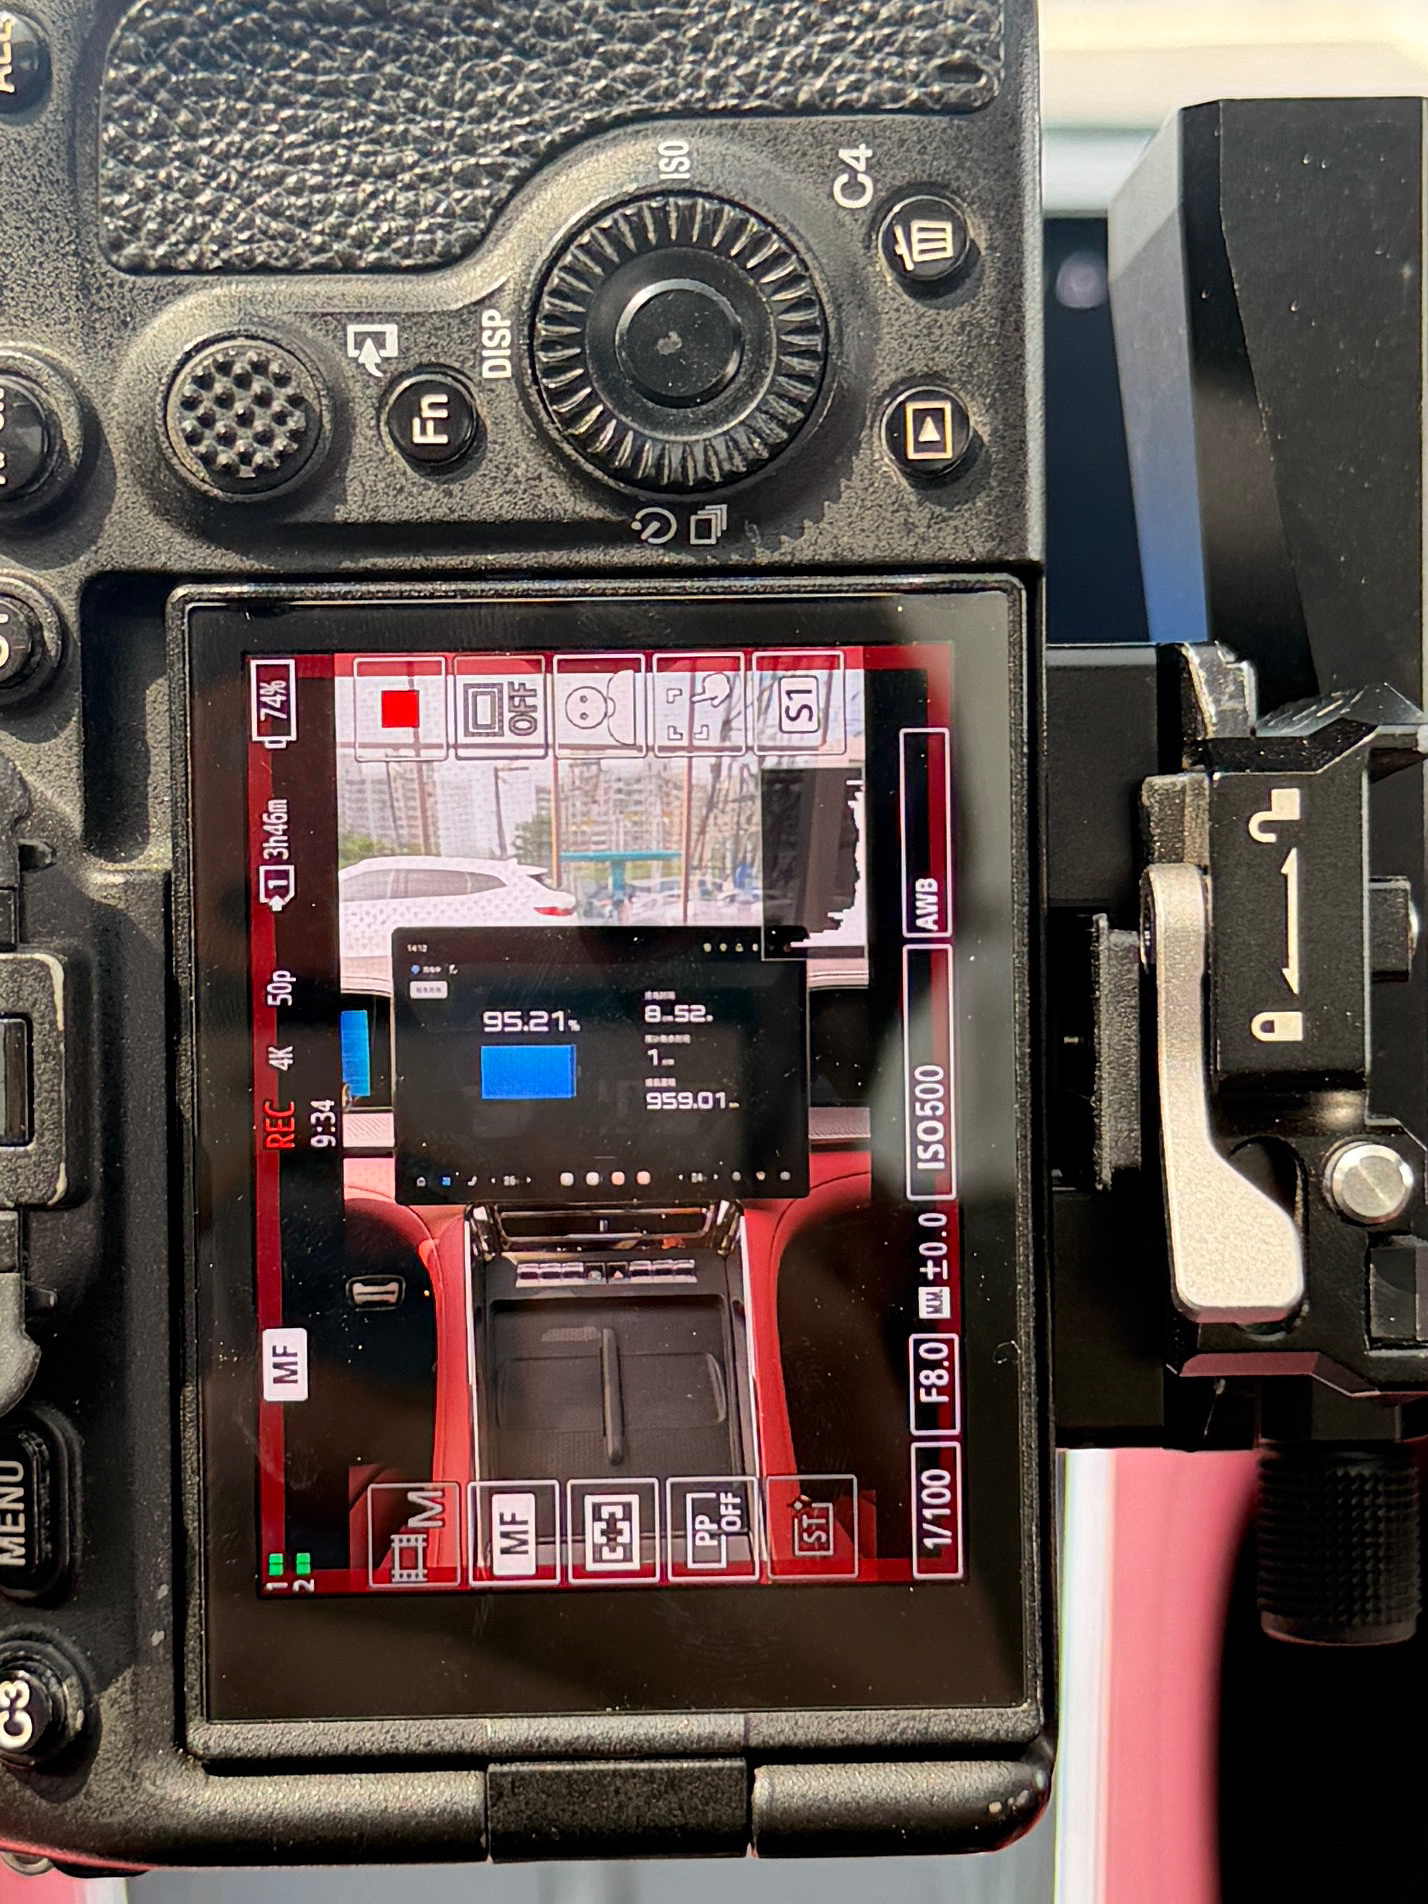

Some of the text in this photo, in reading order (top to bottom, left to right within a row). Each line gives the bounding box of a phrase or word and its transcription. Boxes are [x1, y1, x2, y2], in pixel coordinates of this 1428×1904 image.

[659, 140, 690, 180] ISO
[834, 144, 873, 209] C4
[482, 308, 512, 379] DISP
[411, 393, 449, 445] Fn
[260, 679, 287, 722] 74%
[507, 680, 538, 736] OFF
[262, 798, 289, 860] 3h46m
[915, 878, 939, 931] AWB
[267, 970, 297, 1006] 50p
[268, 1045, 294, 1072] 4K
[264, 1100, 295, 1151] REC
[310, 1099, 337, 1148] 9:34
[914, 1064, 946, 1171] ISO500
[272, 1344, 299, 1385] MF
[919, 1341, 950, 1404] F8.0
[407, 1490, 444, 1528] M
[499, 1512, 530, 1556] MF
[695, 1514, 719, 1546] PP
[719, 1492, 742, 1533] OFF
[920, 1468, 953, 1550] 1/100
